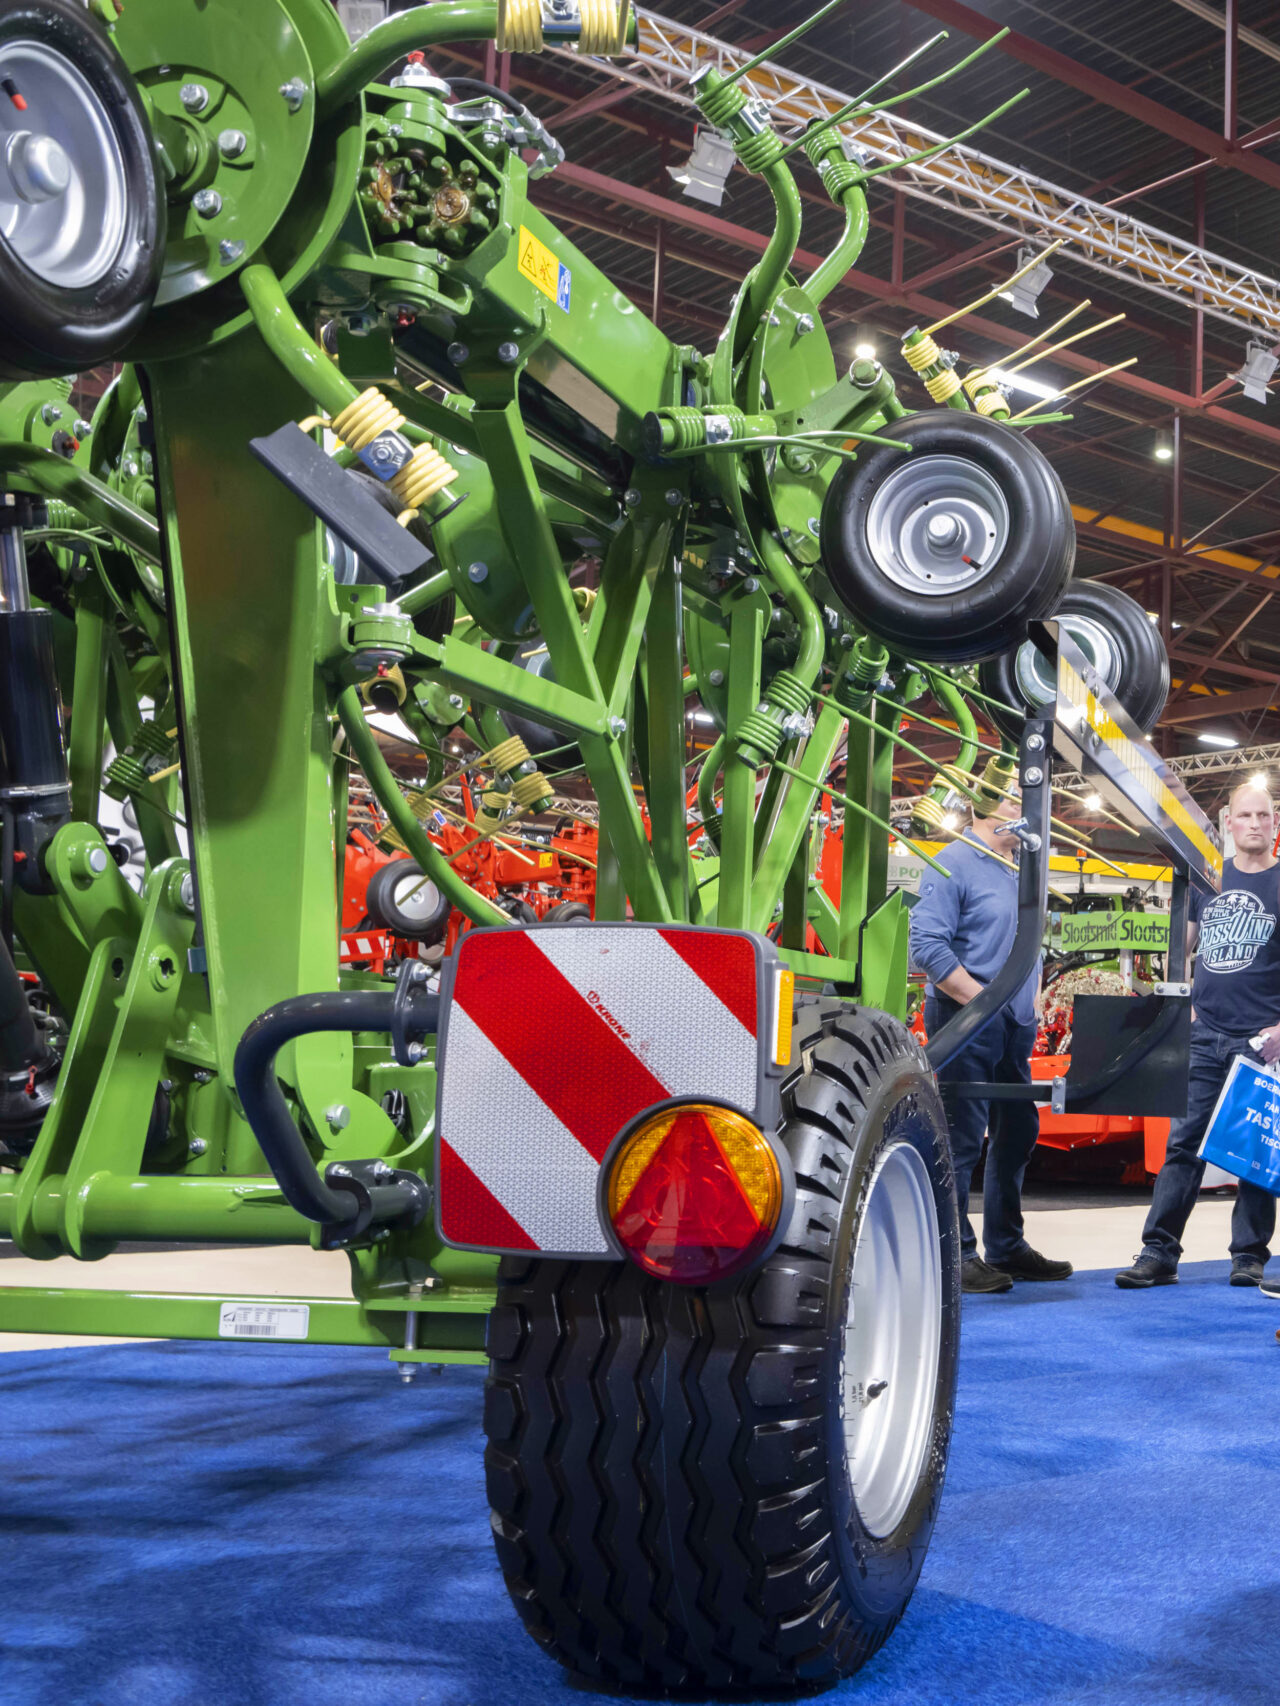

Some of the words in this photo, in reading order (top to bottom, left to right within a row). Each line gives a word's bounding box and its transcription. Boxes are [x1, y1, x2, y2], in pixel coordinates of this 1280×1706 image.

[1200, 908, 1275, 951] ROSSWIND
[595, 1003, 632, 1040] KRONE
[1245, 1106, 1272, 1130] TAS
